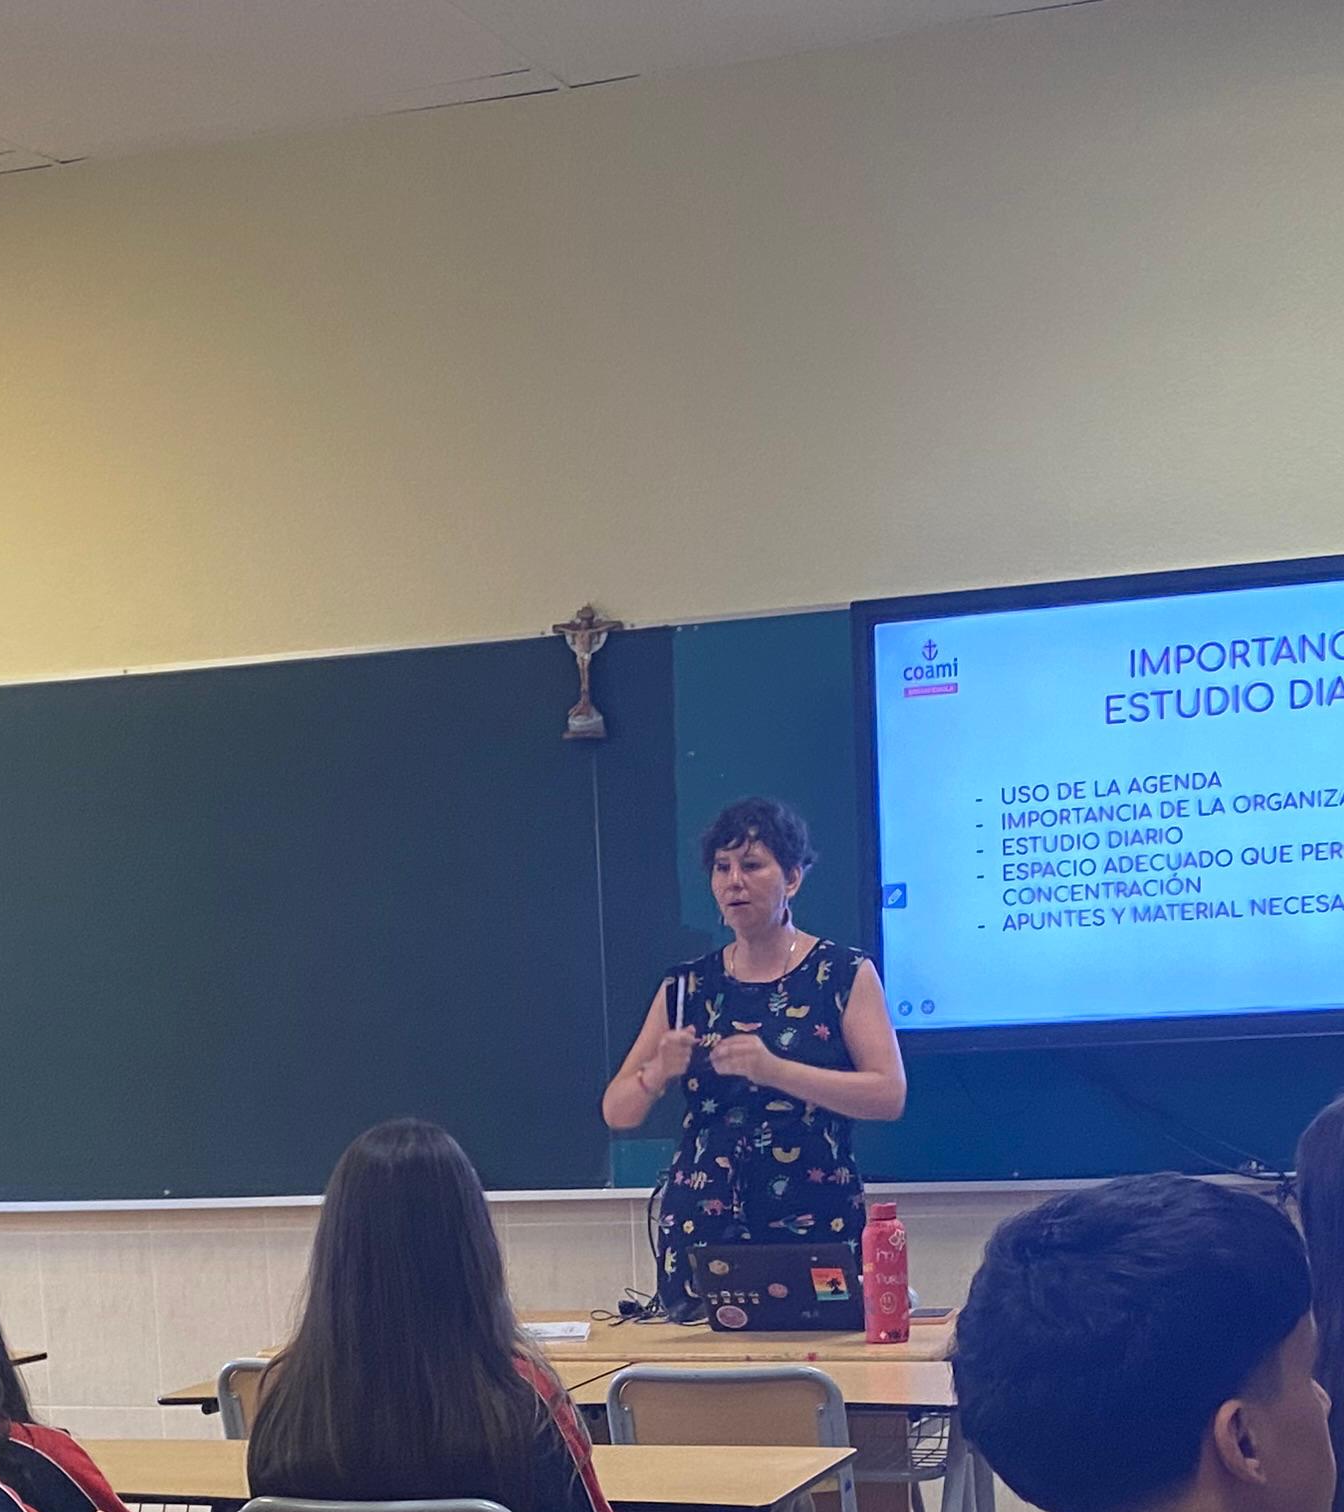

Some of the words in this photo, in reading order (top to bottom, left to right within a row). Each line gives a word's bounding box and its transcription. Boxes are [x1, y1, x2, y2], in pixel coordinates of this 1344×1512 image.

[903, 657, 959, 681] coami
[1104, 681, 1275, 725] ESTUDIO
[1001, 783, 1050, 806] USO
[1056, 780, 1087, 801] DE
[1093, 778, 1121, 799] LA
[1127, 770, 1223, 795] AGENDA
[1001, 802, 1153, 831] IMPORTANCIA
[1159, 799, 1191, 820] DE
[1197, 796, 1226, 817] LA
[1002, 831, 1101, 857] ESTUDIO
[1107, 826, 1184, 850] DIARIO
[1002, 857, 1097, 882] ESPACIO
[1103, 848, 1234, 875] ADECUADO
[1240, 844, 1294, 867] QUE
[1002, 872, 1202, 907] CONCENTRACIÓN
[1002, 907, 1106, 932] APUNTES
[1110, 907, 1126, 925] Y
[1130, 900, 1244, 924] MATERIAL
